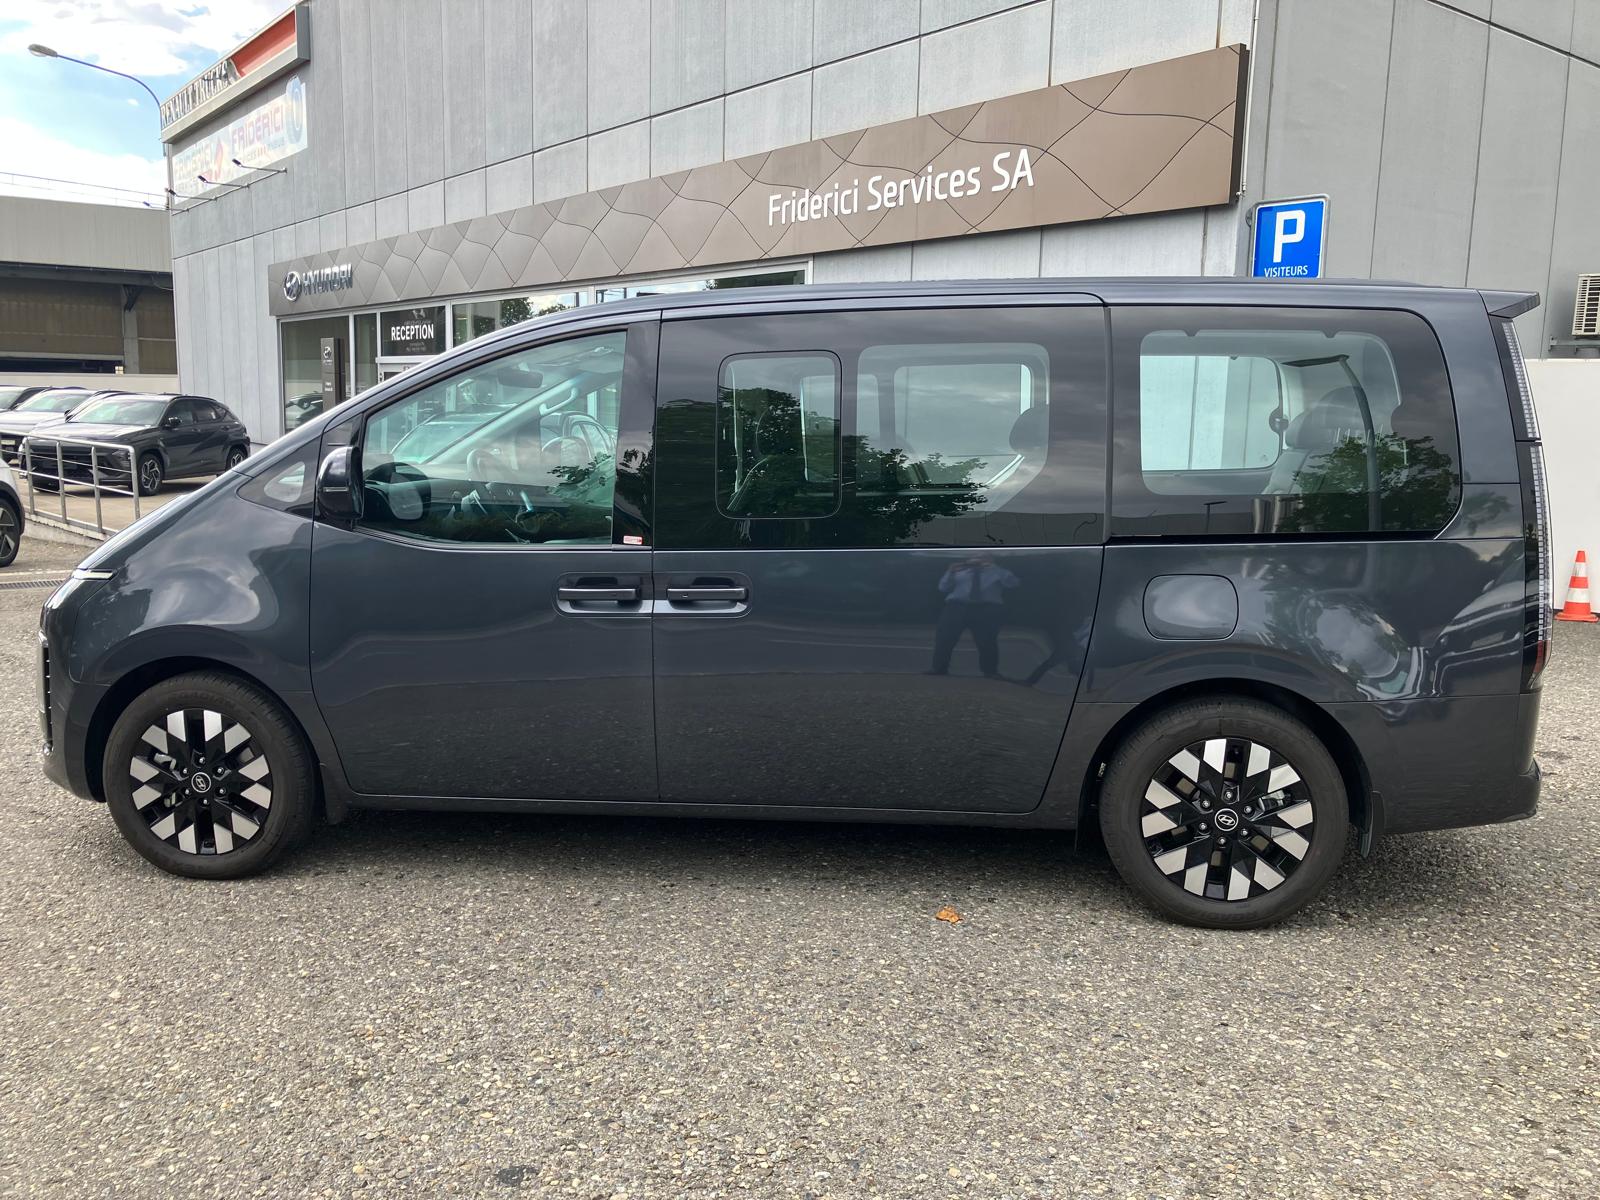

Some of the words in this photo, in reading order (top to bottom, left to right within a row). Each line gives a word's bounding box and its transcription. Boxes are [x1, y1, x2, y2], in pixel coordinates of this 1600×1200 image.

[161, 85, 193, 128] RENAULT
[768, 179, 859, 226] Friderici
[867, 165, 981, 212] Services
[991, 148, 1034, 192] SA
[1272, 209, 1306, 264] P
[302, 264, 352, 296] HYUNDAI
[1264, 264, 1309, 278] VISITEURS
[391, 323, 434, 341] RECEPTION
